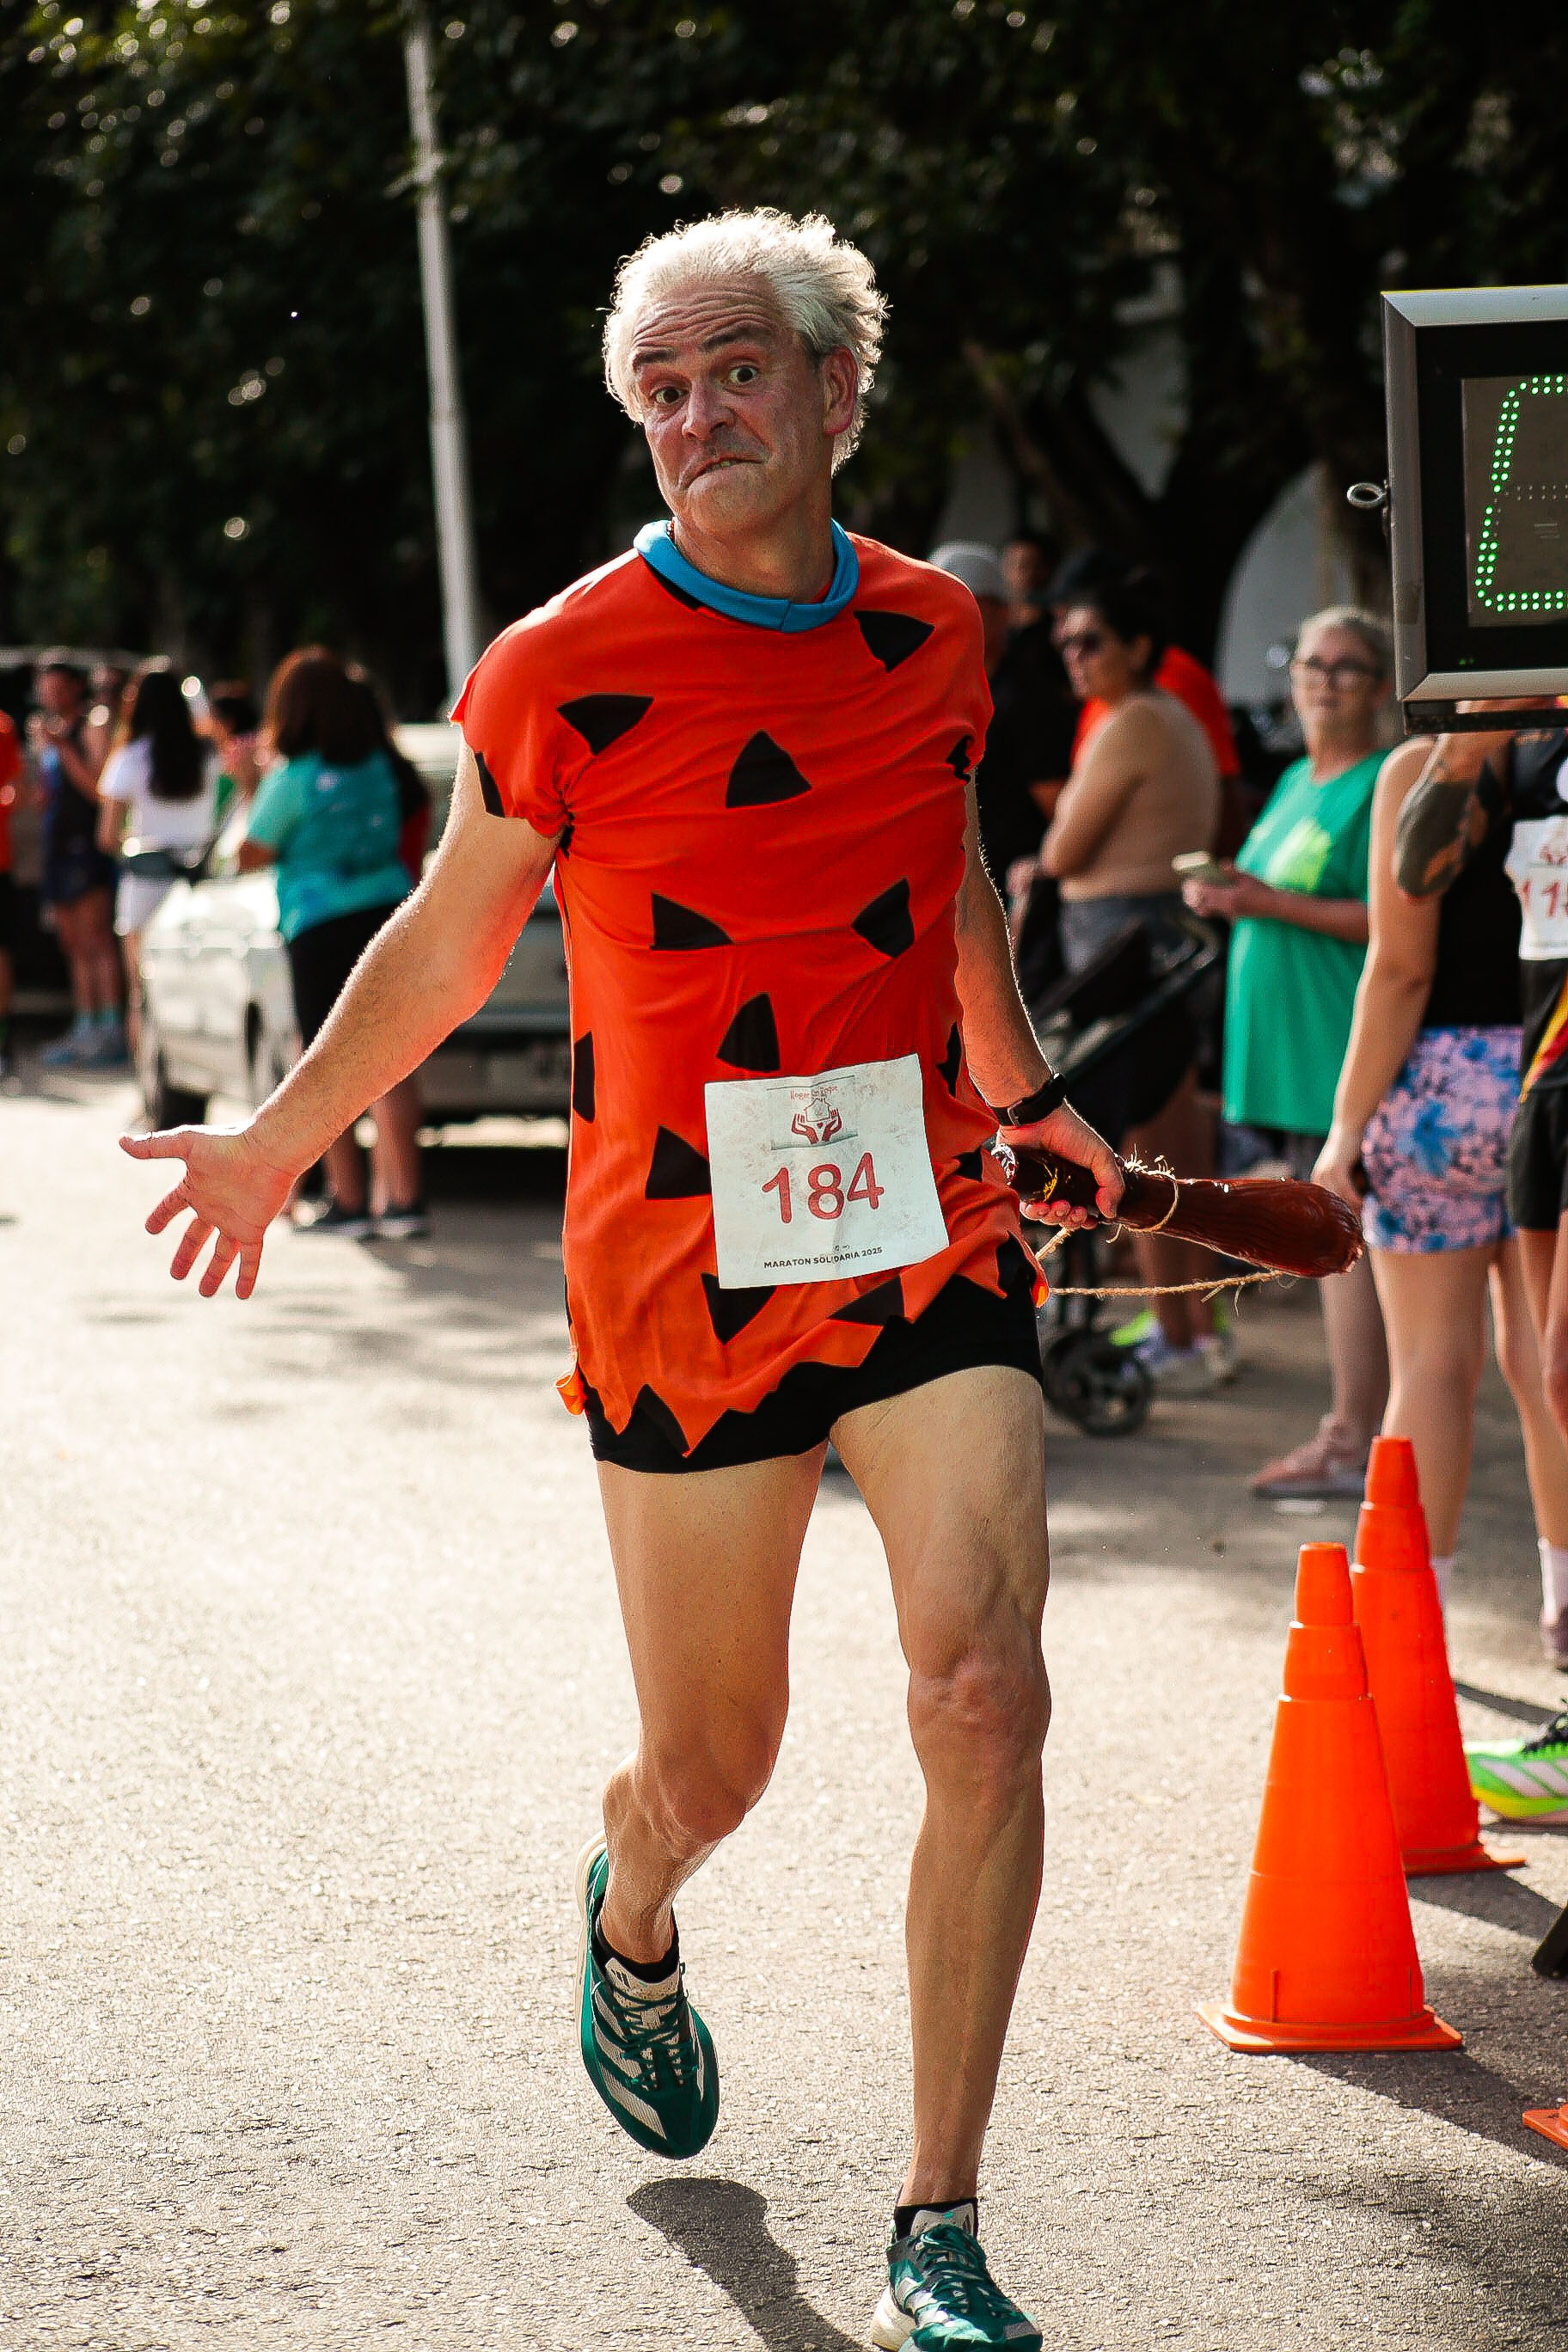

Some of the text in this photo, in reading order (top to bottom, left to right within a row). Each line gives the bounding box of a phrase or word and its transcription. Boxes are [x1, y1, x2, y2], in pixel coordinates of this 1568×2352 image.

[762, 1152, 885, 1223] 184
[763, 1246, 883, 1269] MARATON SOLIDARIA 2025
